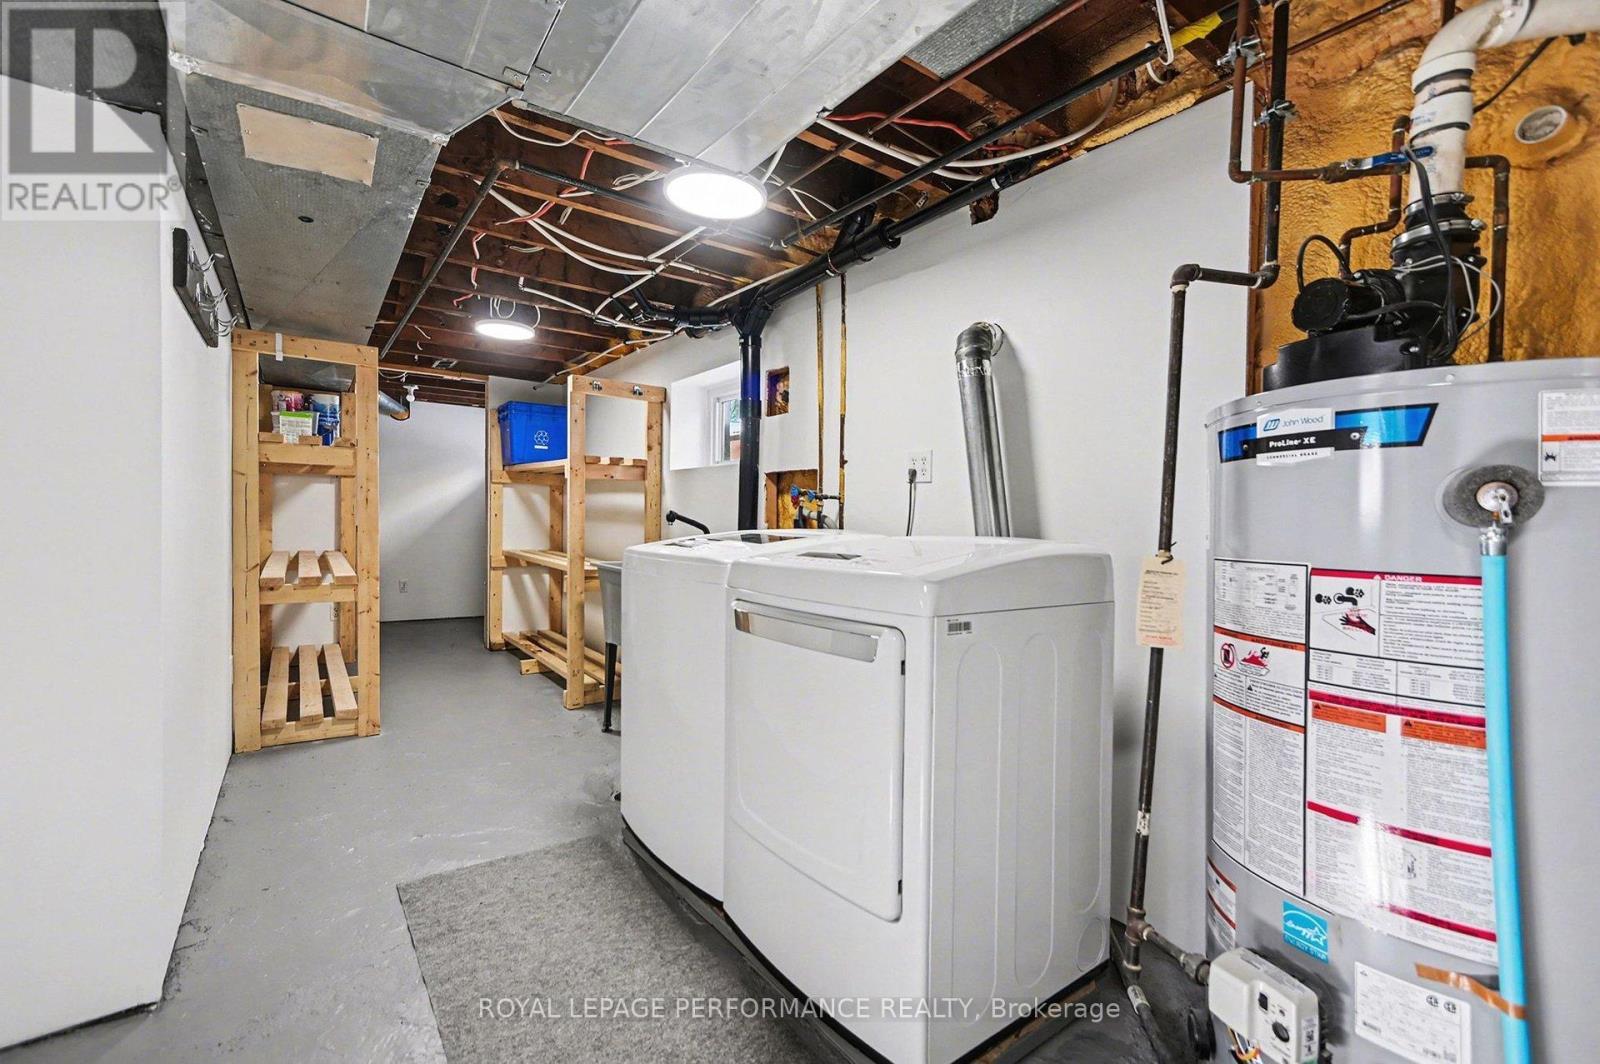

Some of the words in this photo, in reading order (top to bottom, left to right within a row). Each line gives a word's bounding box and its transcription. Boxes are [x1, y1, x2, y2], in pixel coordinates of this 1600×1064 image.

[1282, 418, 1299, 428] John
[1301, 416, 1324, 425] Wood
[1384, 574, 1423, 583] DANGER
